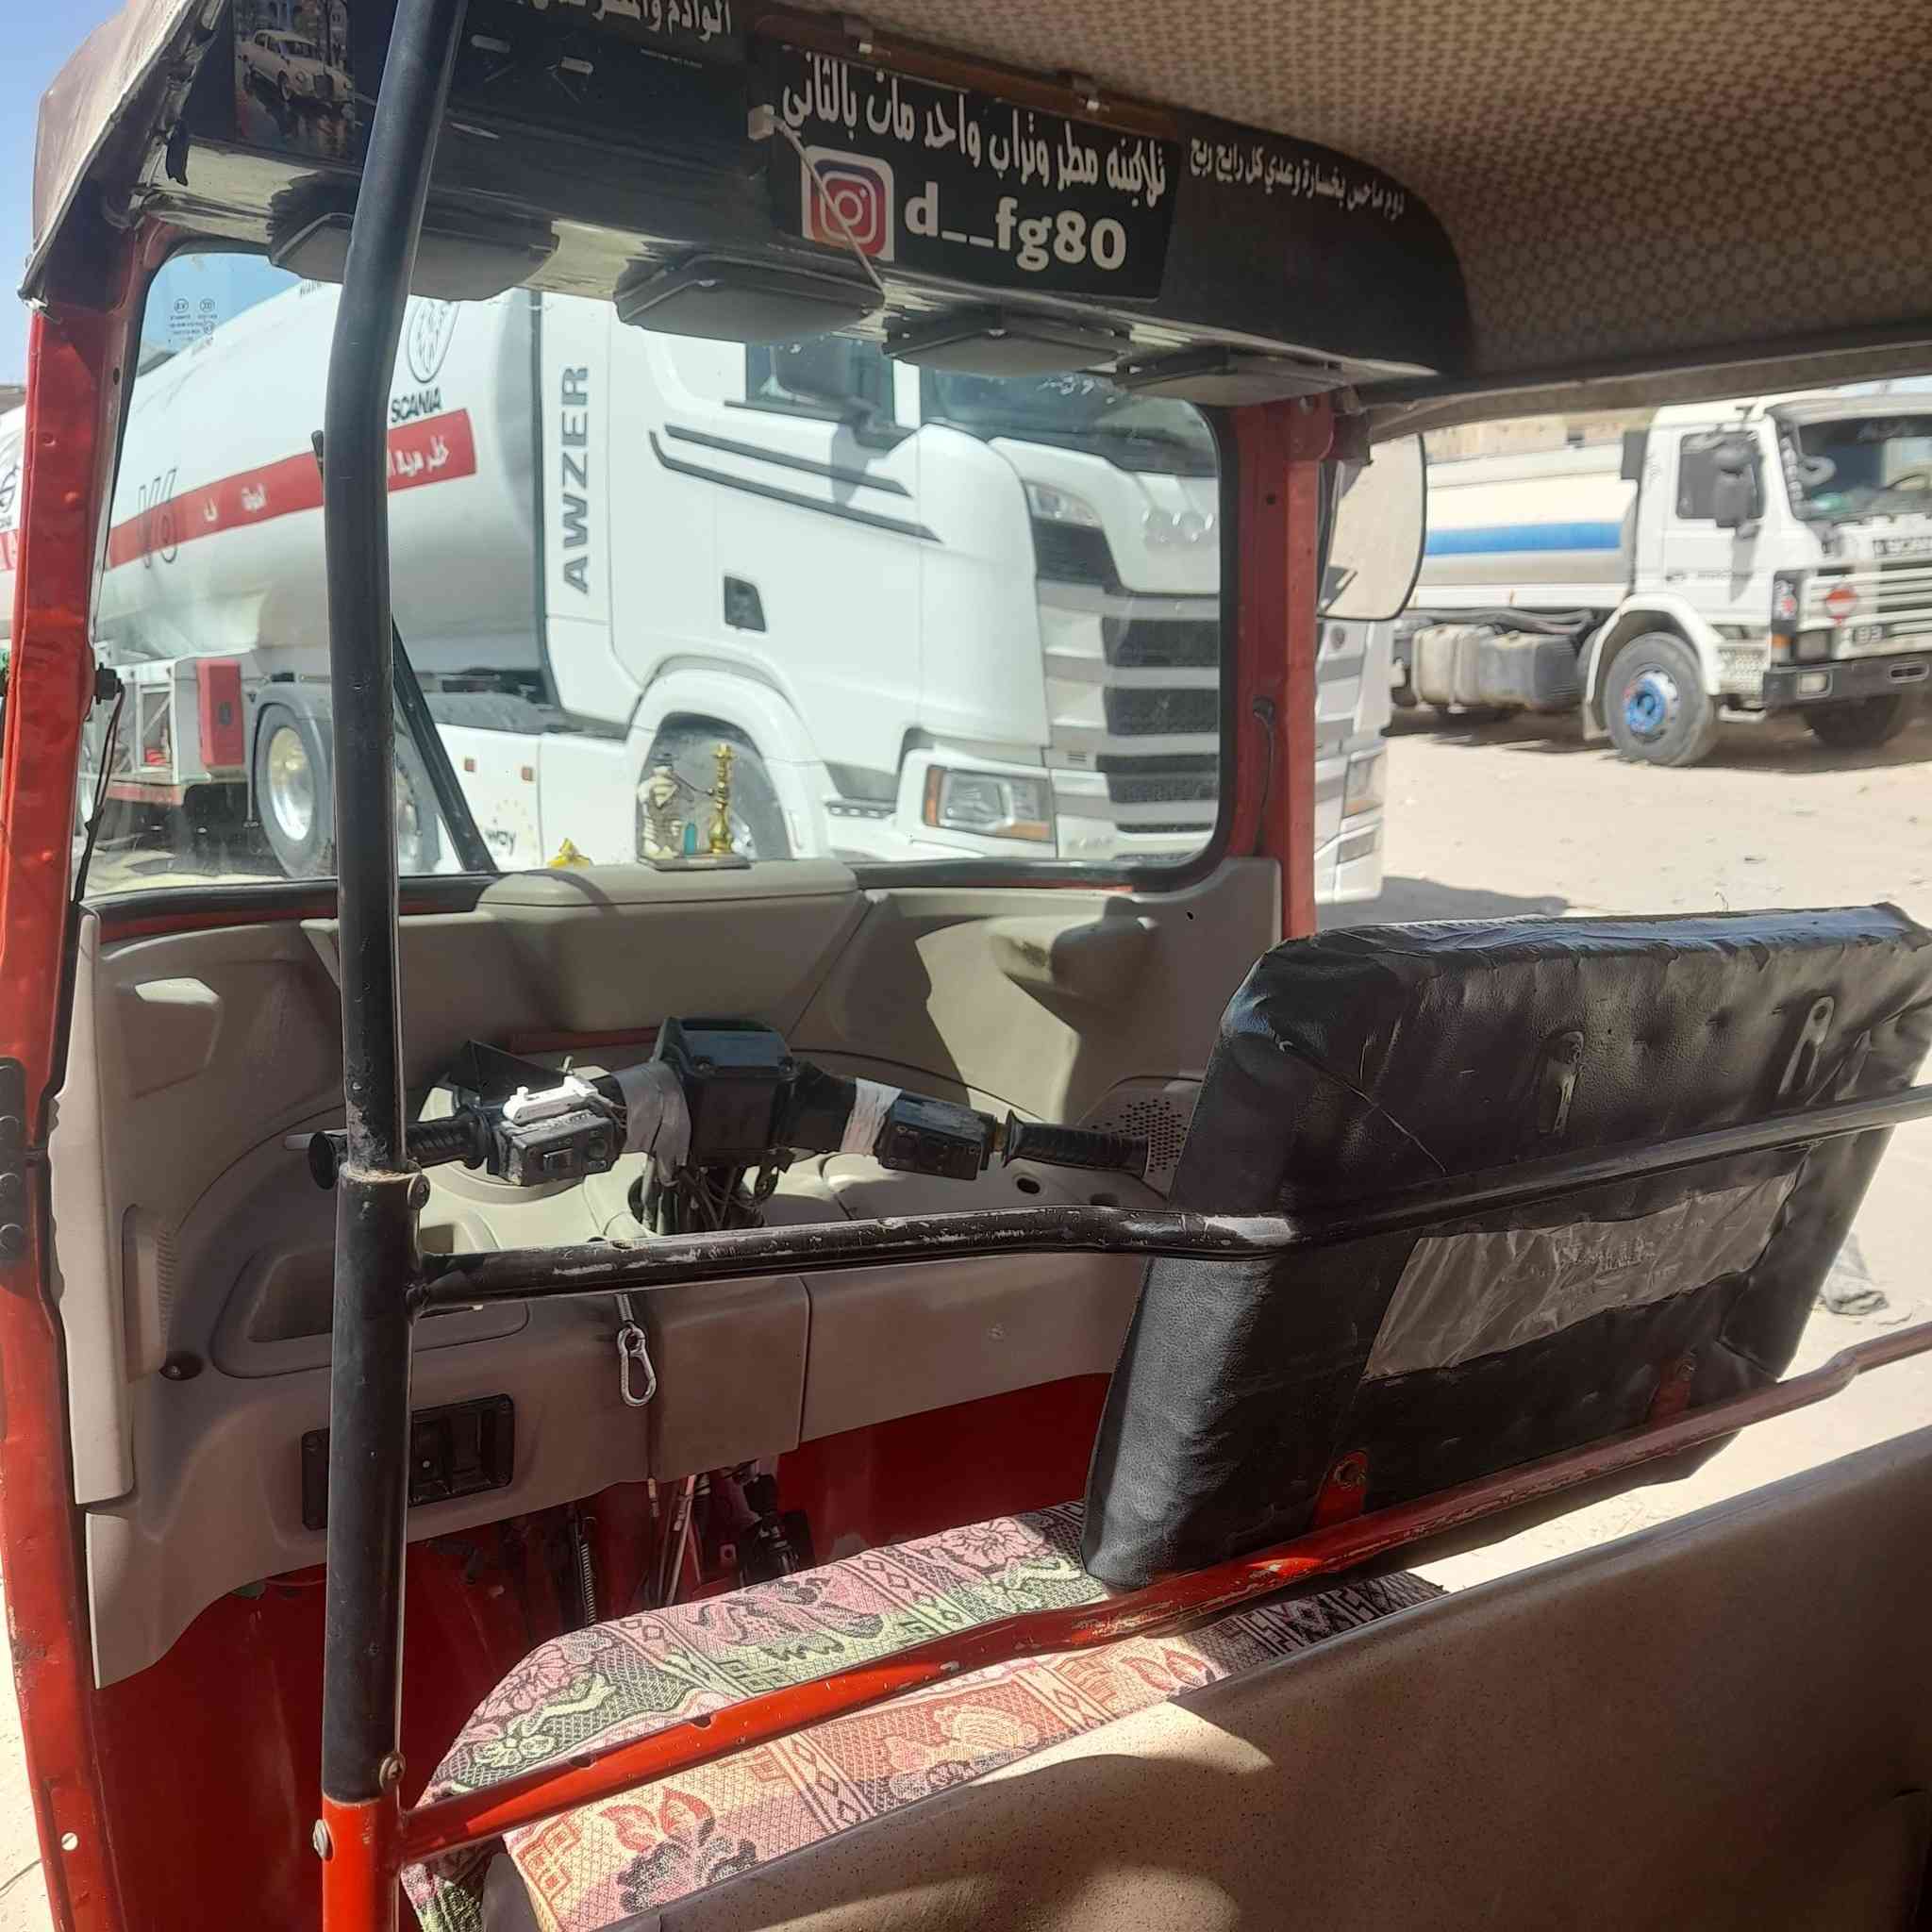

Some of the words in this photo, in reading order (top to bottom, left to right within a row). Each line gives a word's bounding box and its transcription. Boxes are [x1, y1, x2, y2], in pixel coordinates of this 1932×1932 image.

[924, 94, 980, 168] واحد
[1058, 121, 1098, 191] مطر
[1245, 145, 1264, 184] كل
[391, 387, 442, 424] SCANIA
[561, 366, 589, 595] AWZER
